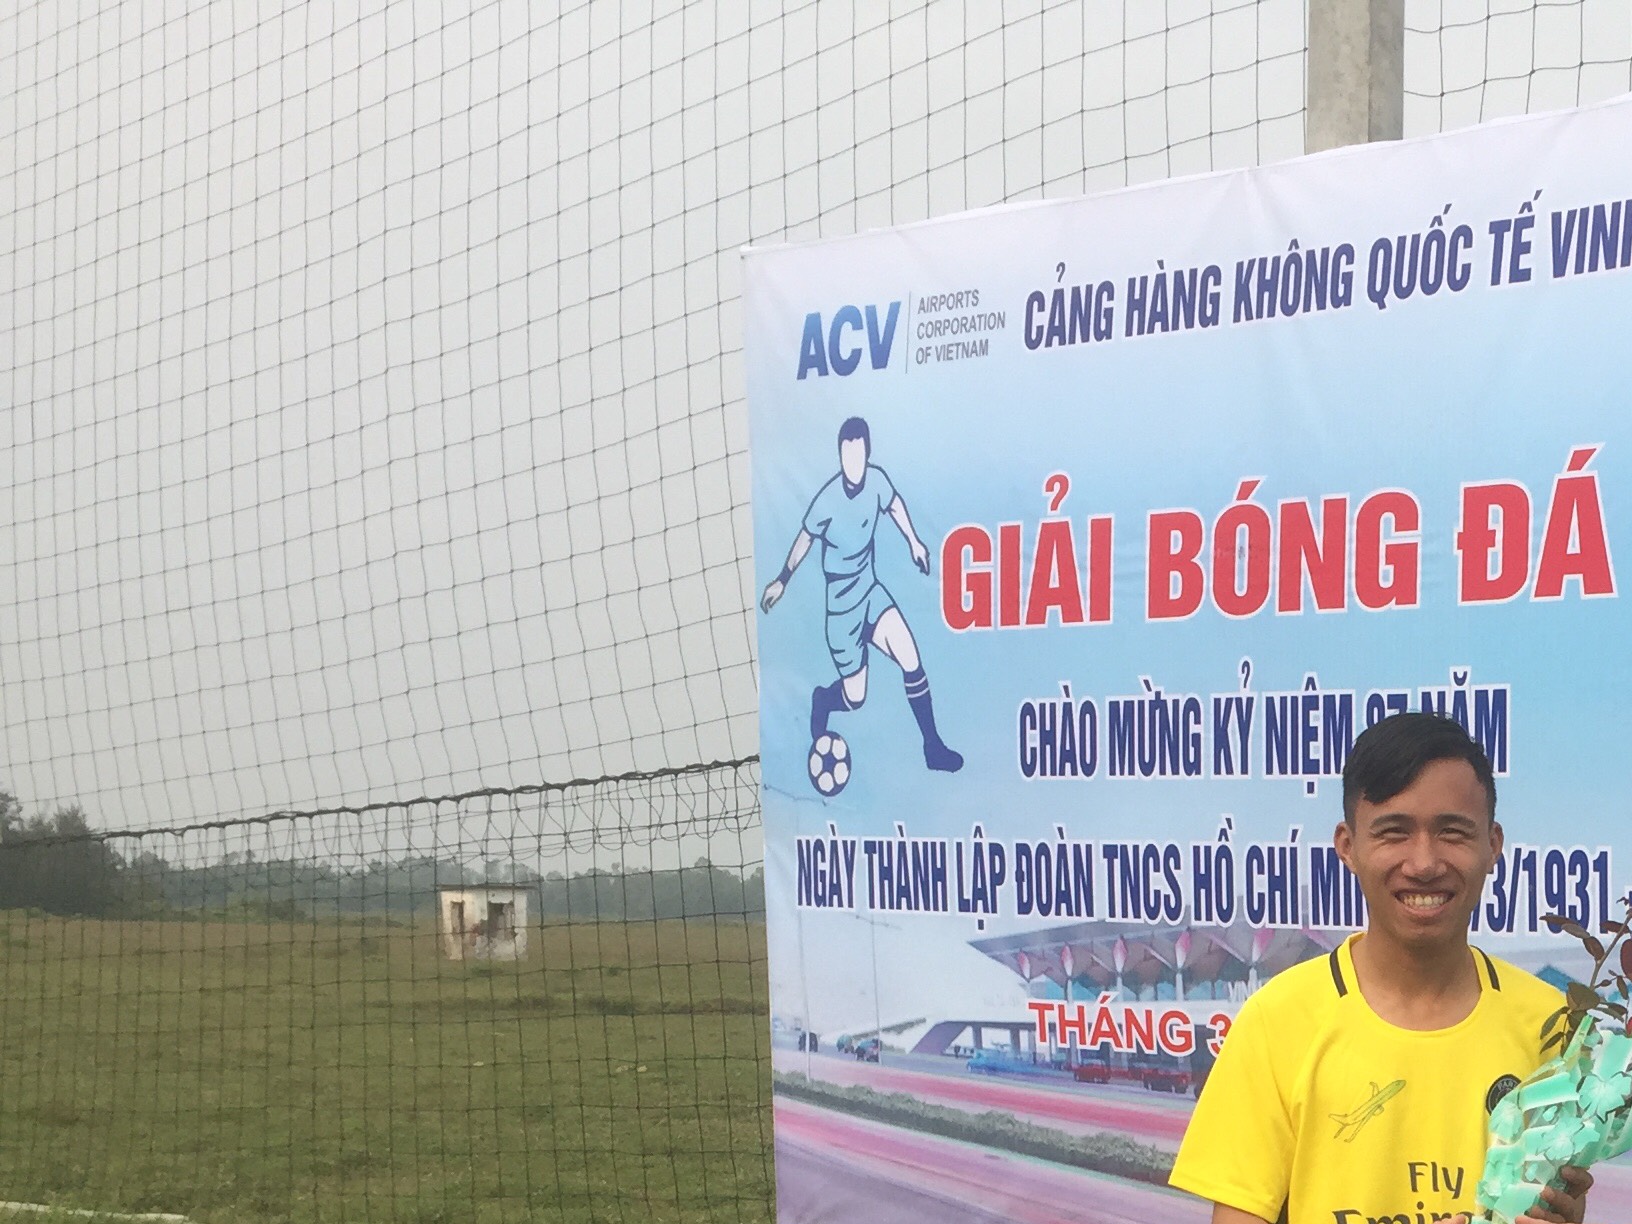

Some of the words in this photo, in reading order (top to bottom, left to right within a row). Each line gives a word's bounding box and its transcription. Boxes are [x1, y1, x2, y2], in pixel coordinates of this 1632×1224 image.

[917, 289, 979, 315] AIRPORTS
[1024, 262, 1115, 350] CẢNG
[1125, 260, 1222, 337] HÀNG
[1233, 239, 1355, 323] KHÔNG
[1367, 204, 1473, 310] QUỐC
[1488, 189, 1543, 286] TẾ
[797, 300, 901, 380] ACV
[916, 347, 932, 365] OF
[934, 339, 989, 363] VIETNAM
[917, 311, 1006, 340] CORPORATION
[942, 474, 1113, 630] GIẢI
[1149, 479, 1420, 619] BÓNG
[1457, 448, 1614, 602] ĐÁ
[1020, 684, 1097, 778] CHÀO
[1109, 678, 1201, 777] MỪNG
[1213, 660, 1255, 776] KỶ
[1266, 676, 1354, 794] NIỆM
[799, 822, 856, 909] NGÀY
[864, 824, 948, 912] THÀNH
[956, 828, 1004, 930] LẬP
[1016, 827, 1095, 918] ĐOÀN
[1103, 843, 1182, 921] TNCS
[1193, 818, 1235, 923] HỒ
[1246, 829, 1298, 926] CHÍ
[1029, 991, 1197, 1053] THÁNG
[1408, 1161, 1465, 1199] Fly
